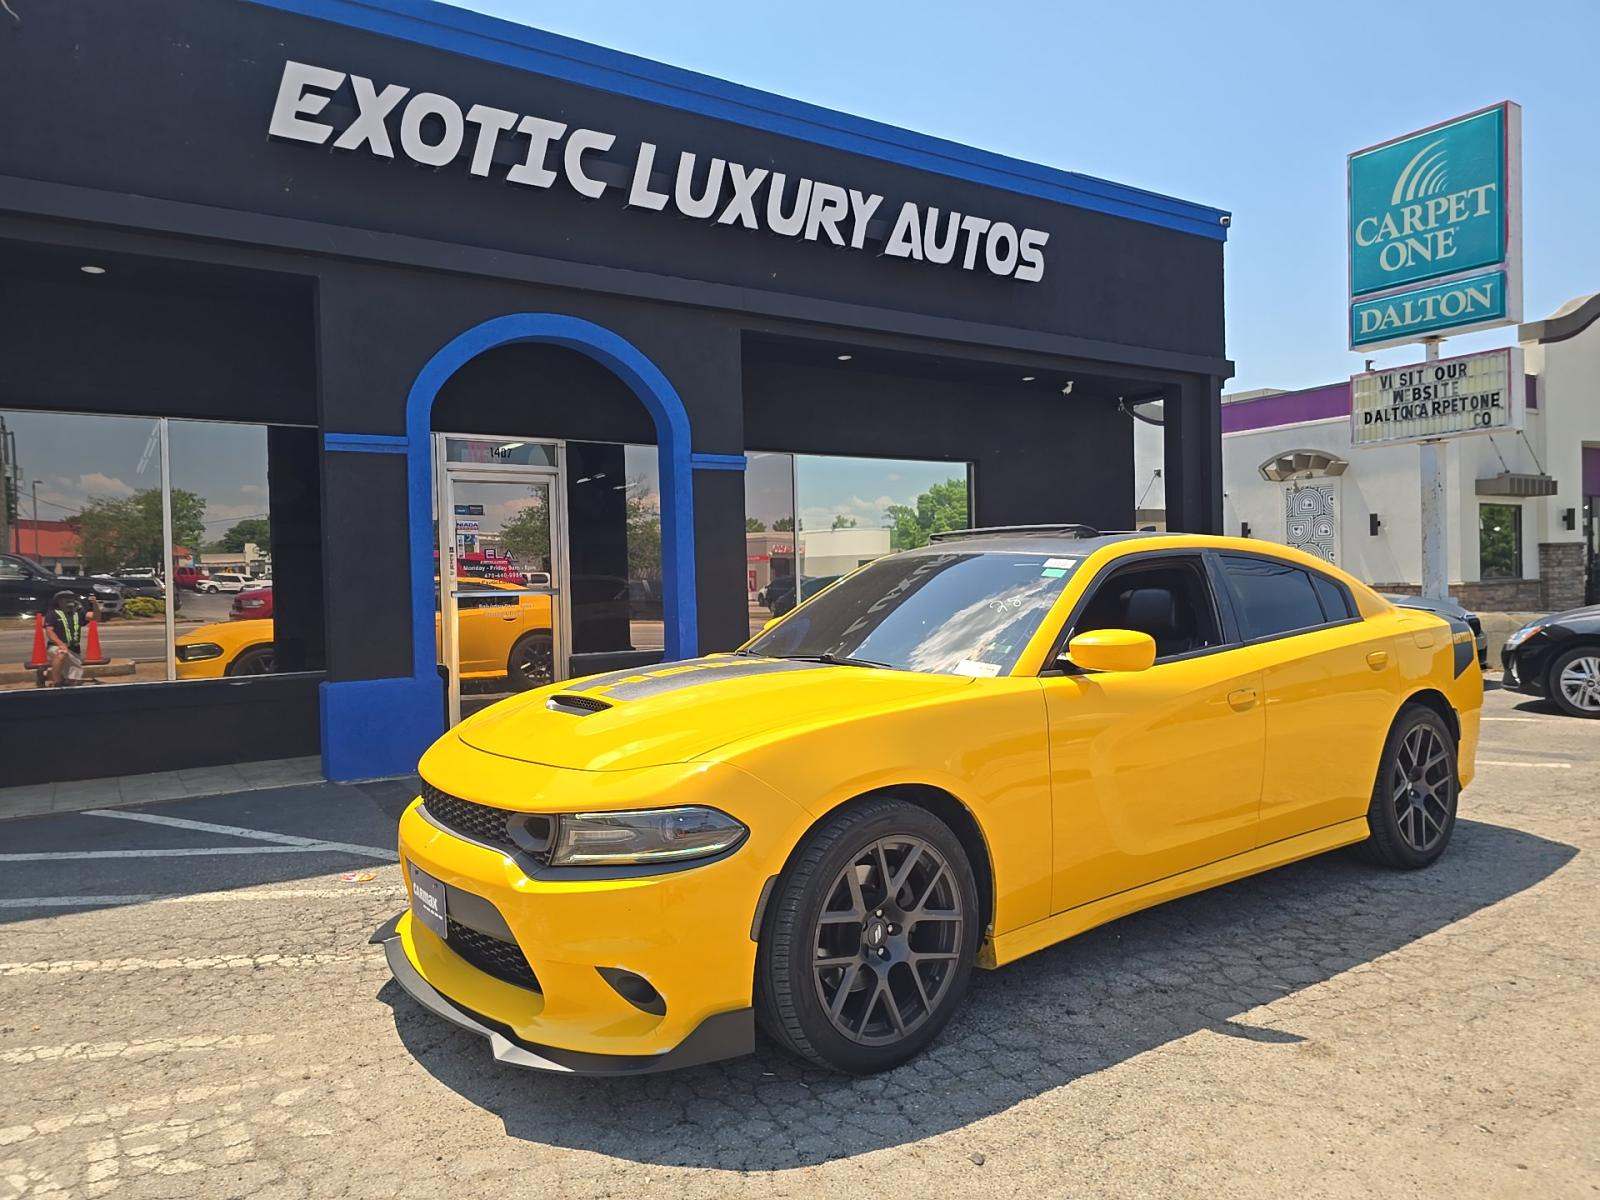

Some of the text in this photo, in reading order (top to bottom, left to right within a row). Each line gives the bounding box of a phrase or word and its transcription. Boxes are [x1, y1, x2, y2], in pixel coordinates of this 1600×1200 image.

[268, 60, 1050, 283] EXOTIC LUXURY AUTOS
[1355, 183, 1496, 247] CARPET
[1379, 228, 1458, 272] ONE
[1360, 283, 1493, 334] DALTON
[1380, 363, 1467, 390] VISIT OUR
[1393, 381, 1459, 405] WEBSITE
[463, 565, 486, 574] Monday
[490, 565, 507, 574] Friday
